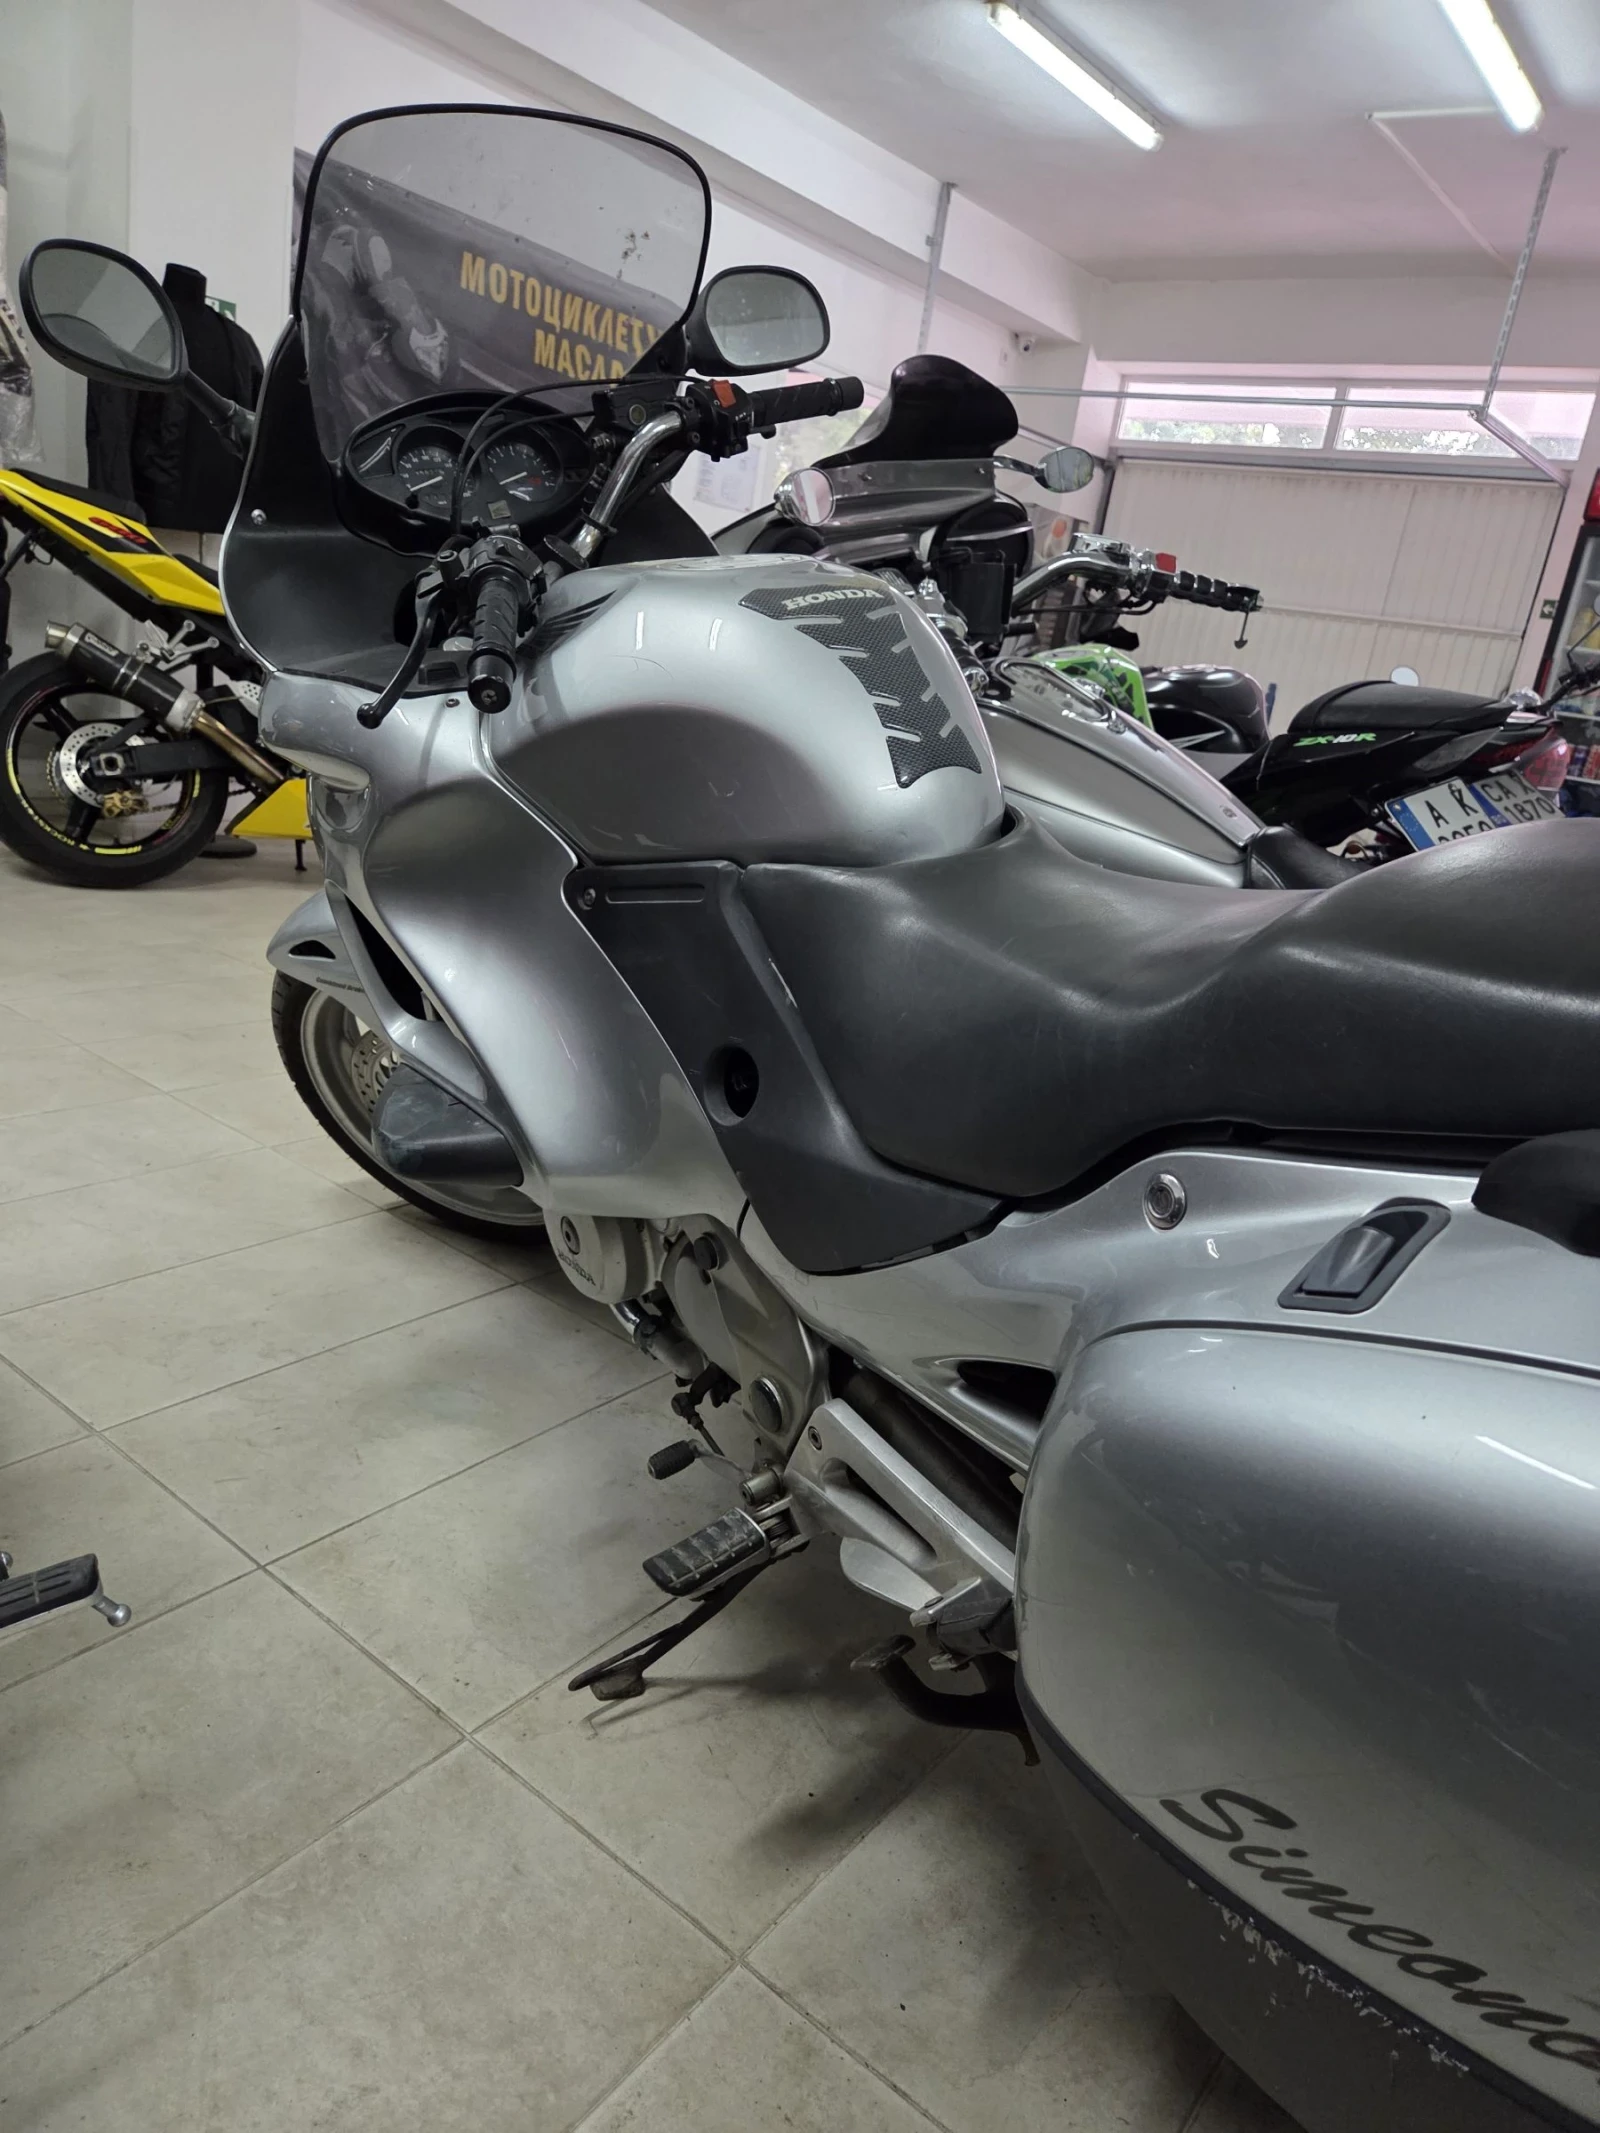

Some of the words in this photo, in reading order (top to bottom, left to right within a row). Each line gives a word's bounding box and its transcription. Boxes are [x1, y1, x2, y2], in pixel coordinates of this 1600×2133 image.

[781, 589, 884, 610] HONDA
[1293, 733, 1377, 747] ZX-10R
[1424, 800, 1450, 828] A
[1447, 783, 1479, 817] K
[1504, 796, 1556, 824] 1870
[557, 1247, 597, 1287] HONDA
[1159, 1788, 1600, 2085] Simeono
